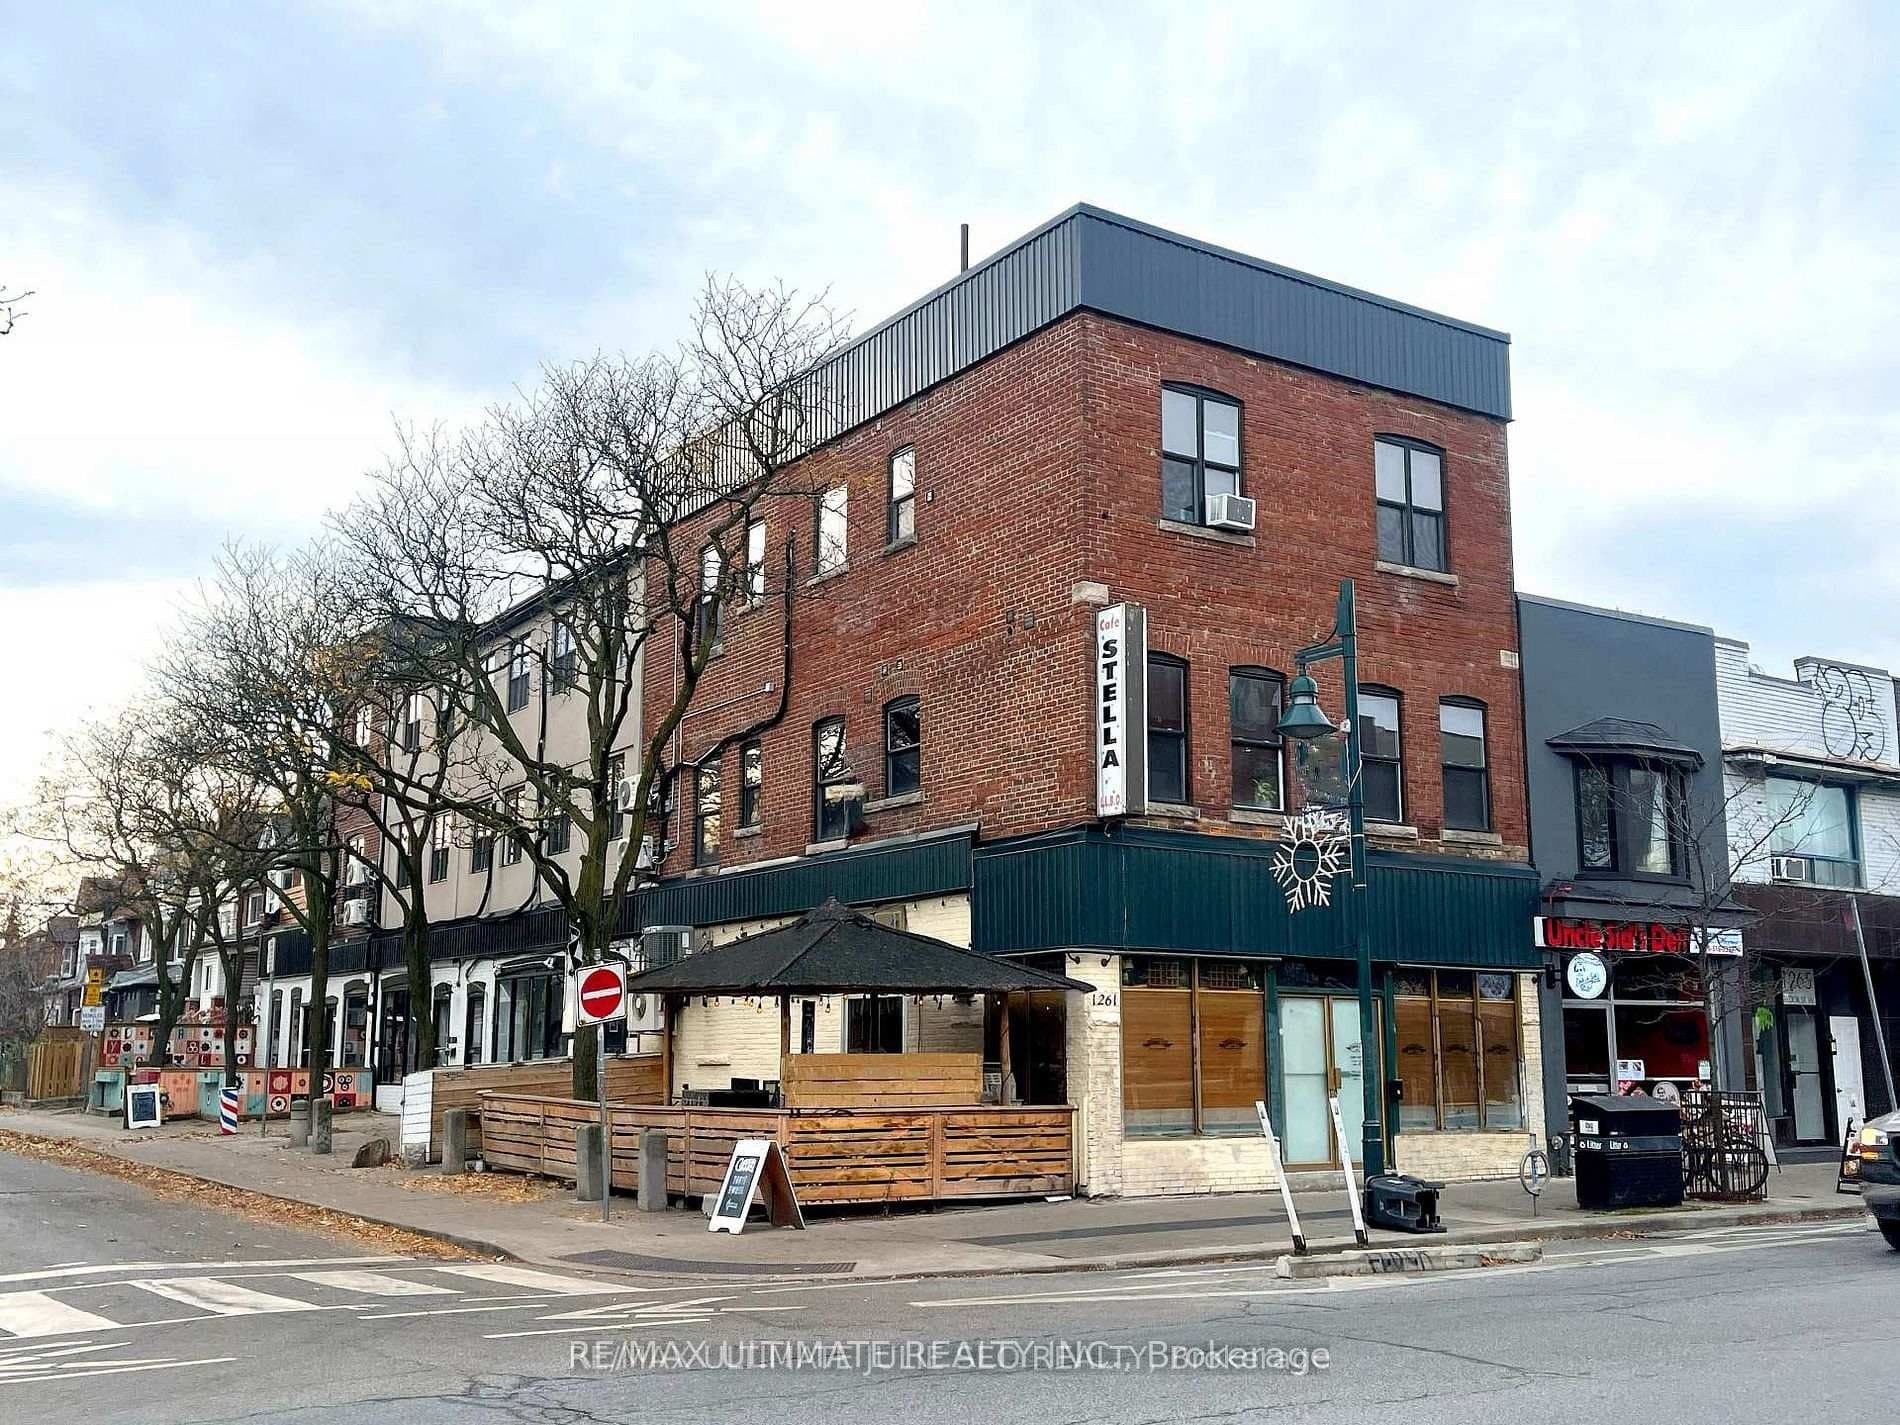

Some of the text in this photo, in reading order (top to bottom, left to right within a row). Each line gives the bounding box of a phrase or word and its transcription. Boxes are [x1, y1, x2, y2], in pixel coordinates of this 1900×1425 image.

[1102, 639, 1120, 769] STELLA
[1545, 917, 1600, 948] Uncle
[1092, 993, 1117, 1007] 1261
